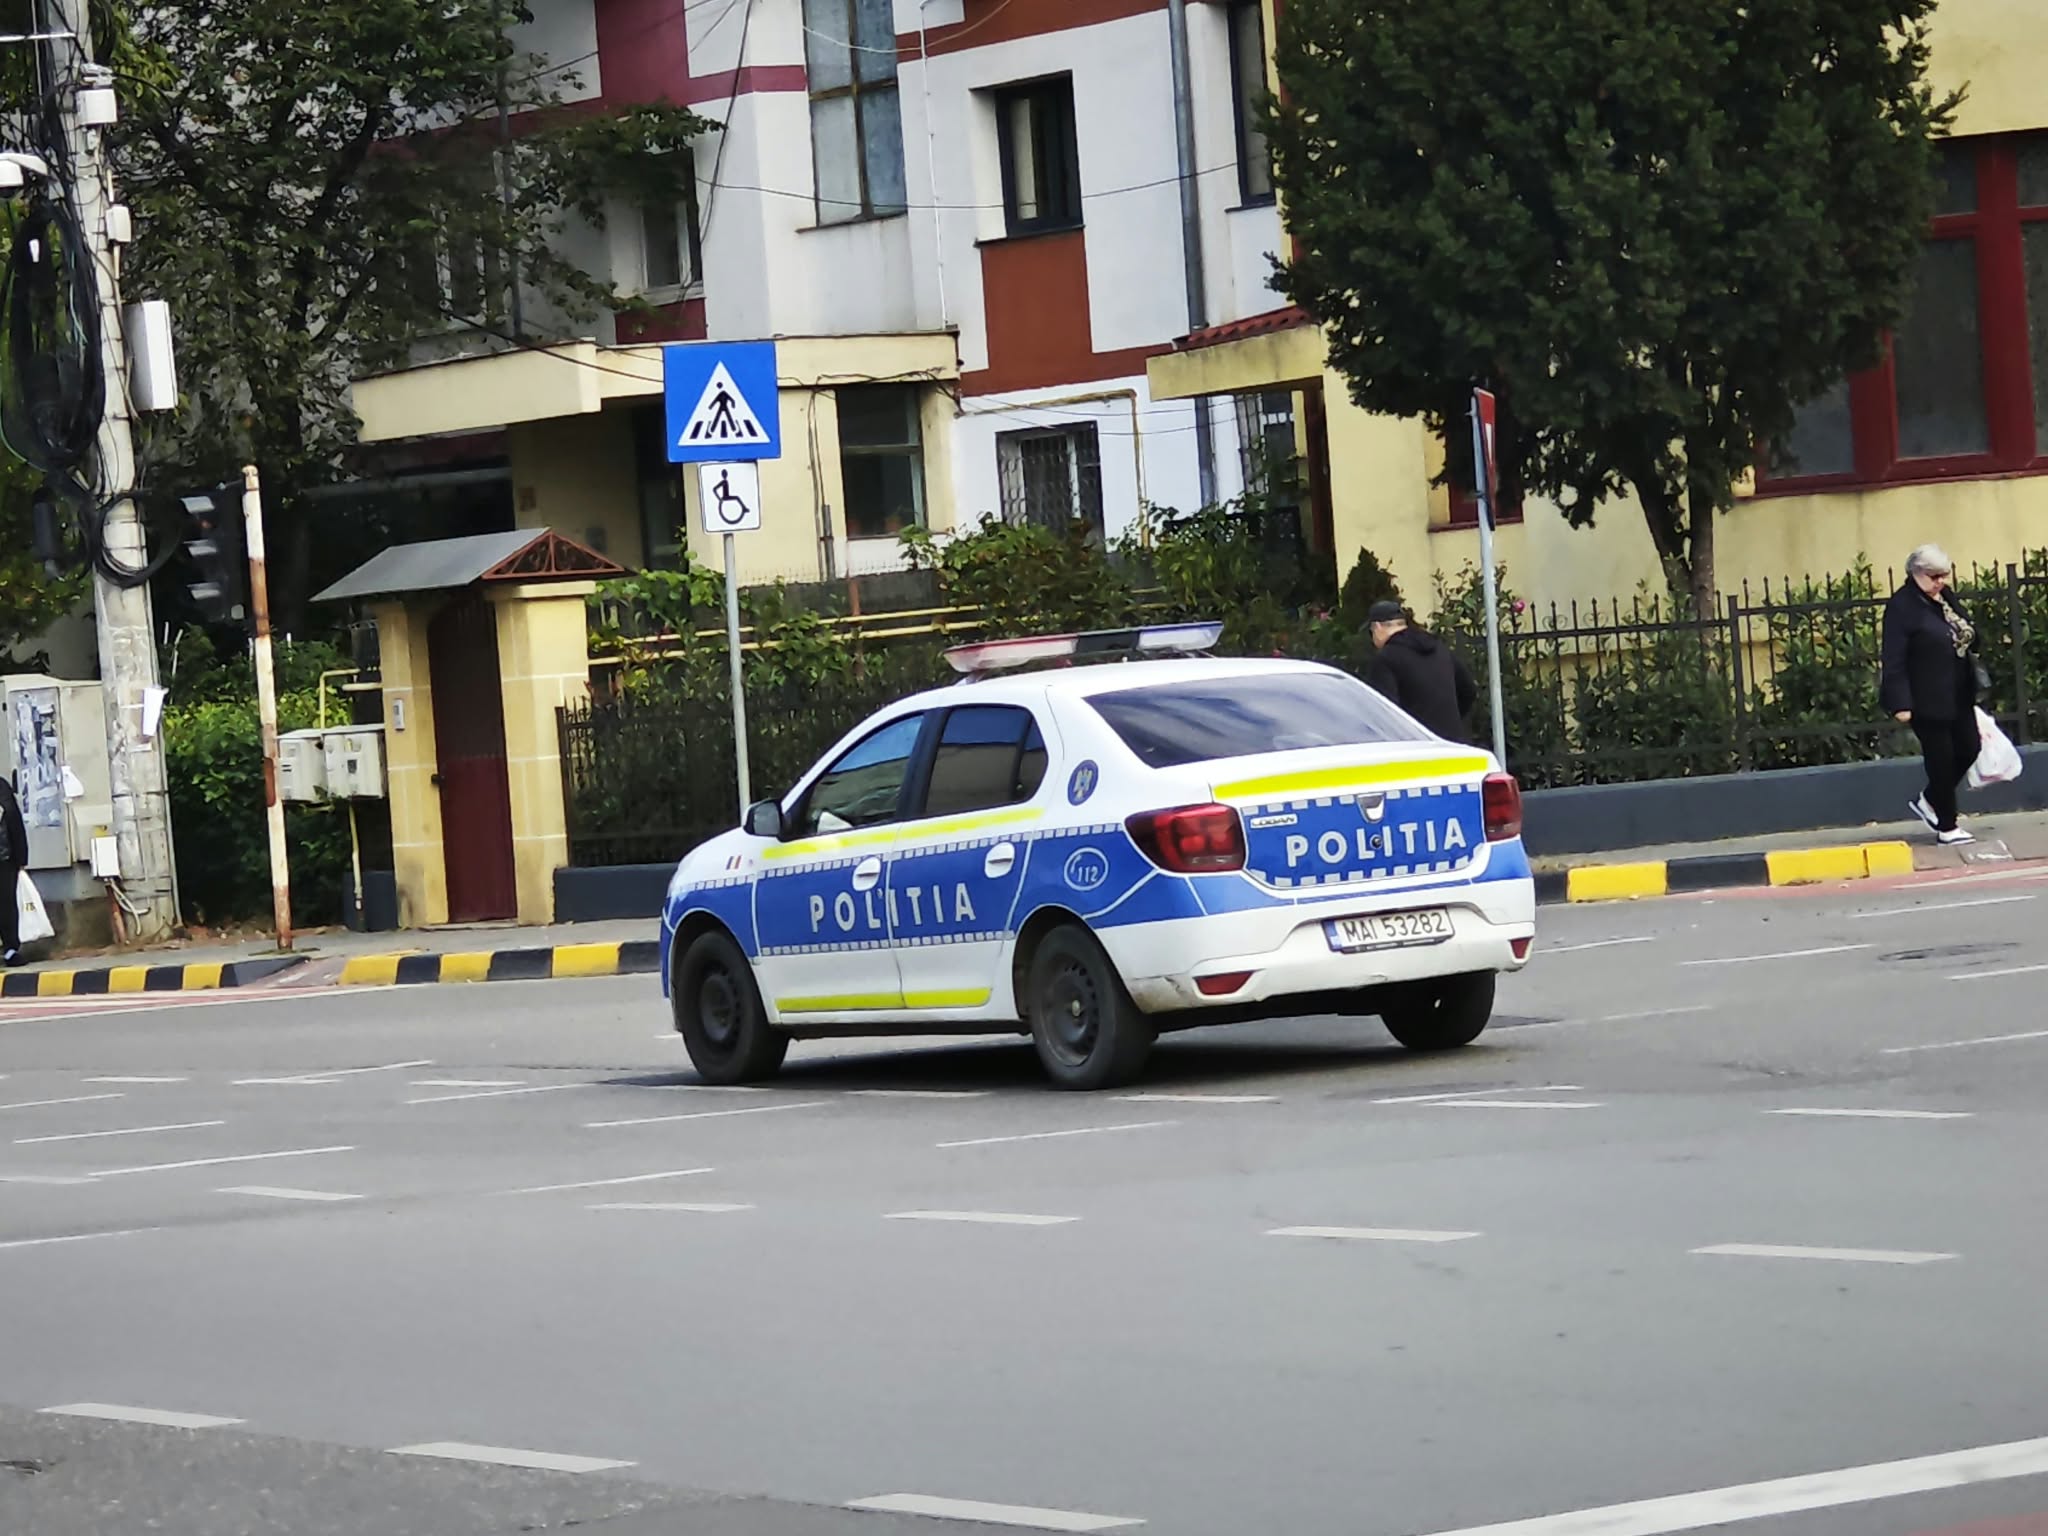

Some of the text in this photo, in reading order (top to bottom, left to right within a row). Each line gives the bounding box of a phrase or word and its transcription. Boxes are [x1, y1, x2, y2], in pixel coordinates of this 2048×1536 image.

[1286, 817, 1467, 868] POLITIA
[1078, 866, 1098, 882] 112
[809, 883, 976, 933] POLITIA
[1342, 911, 1447, 942] MAI 53282
